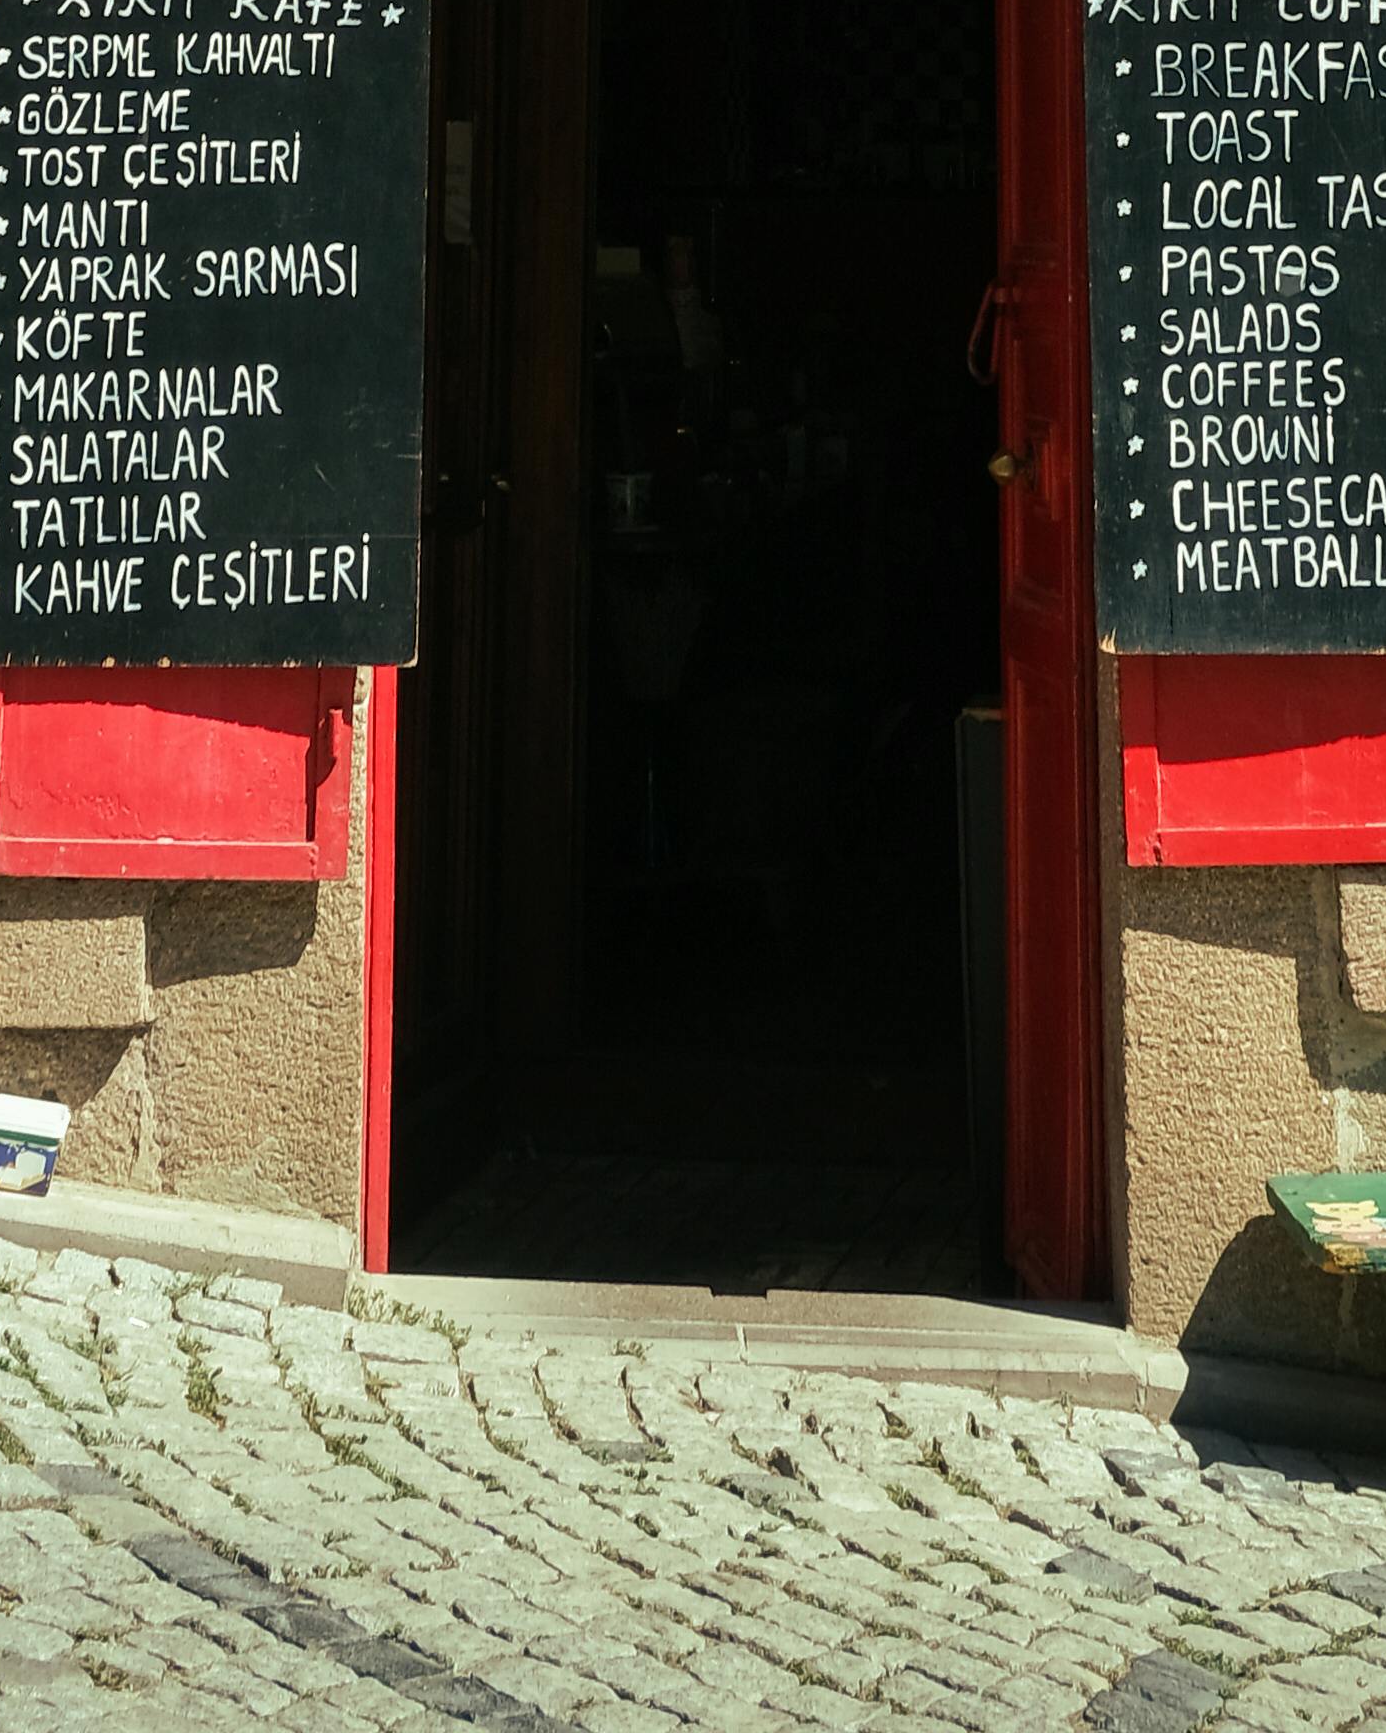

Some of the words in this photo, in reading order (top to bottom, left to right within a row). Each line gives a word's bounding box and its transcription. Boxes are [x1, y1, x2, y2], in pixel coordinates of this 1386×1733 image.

[18, 33, 155, 79] SERPME
[177, 32, 335, 77] KAHVALTI
[18, 87, 190, 134] GÖZLEME
[1156, 110, 1298, 164] TOAST
[18, 145, 106, 187] TOST
[122, 129, 300, 189] ÇEŞİTLERİ
[18, 199, 148, 249] MANTI
[1163, 176, 1296, 229] LOCAL
[20, 253, 170, 302] YAPRAK
[194, 242, 357, 297] SARMASI
[1162, 245, 1339, 296] PASTAS
[17, 307, 146, 361] KÖFTE
[1160, 303, 1321, 356] SALADS
[14, 364, 281, 422] MAKARNALAR
[1162, 358, 1345, 411] COFFEES
[10, 426, 229, 485] SALATALAR
[13, 492, 206, 549] TATLILAR
[15, 557, 144, 614] KAHVE
[171, 533, 369, 611] ÇEŞİTLERİ
